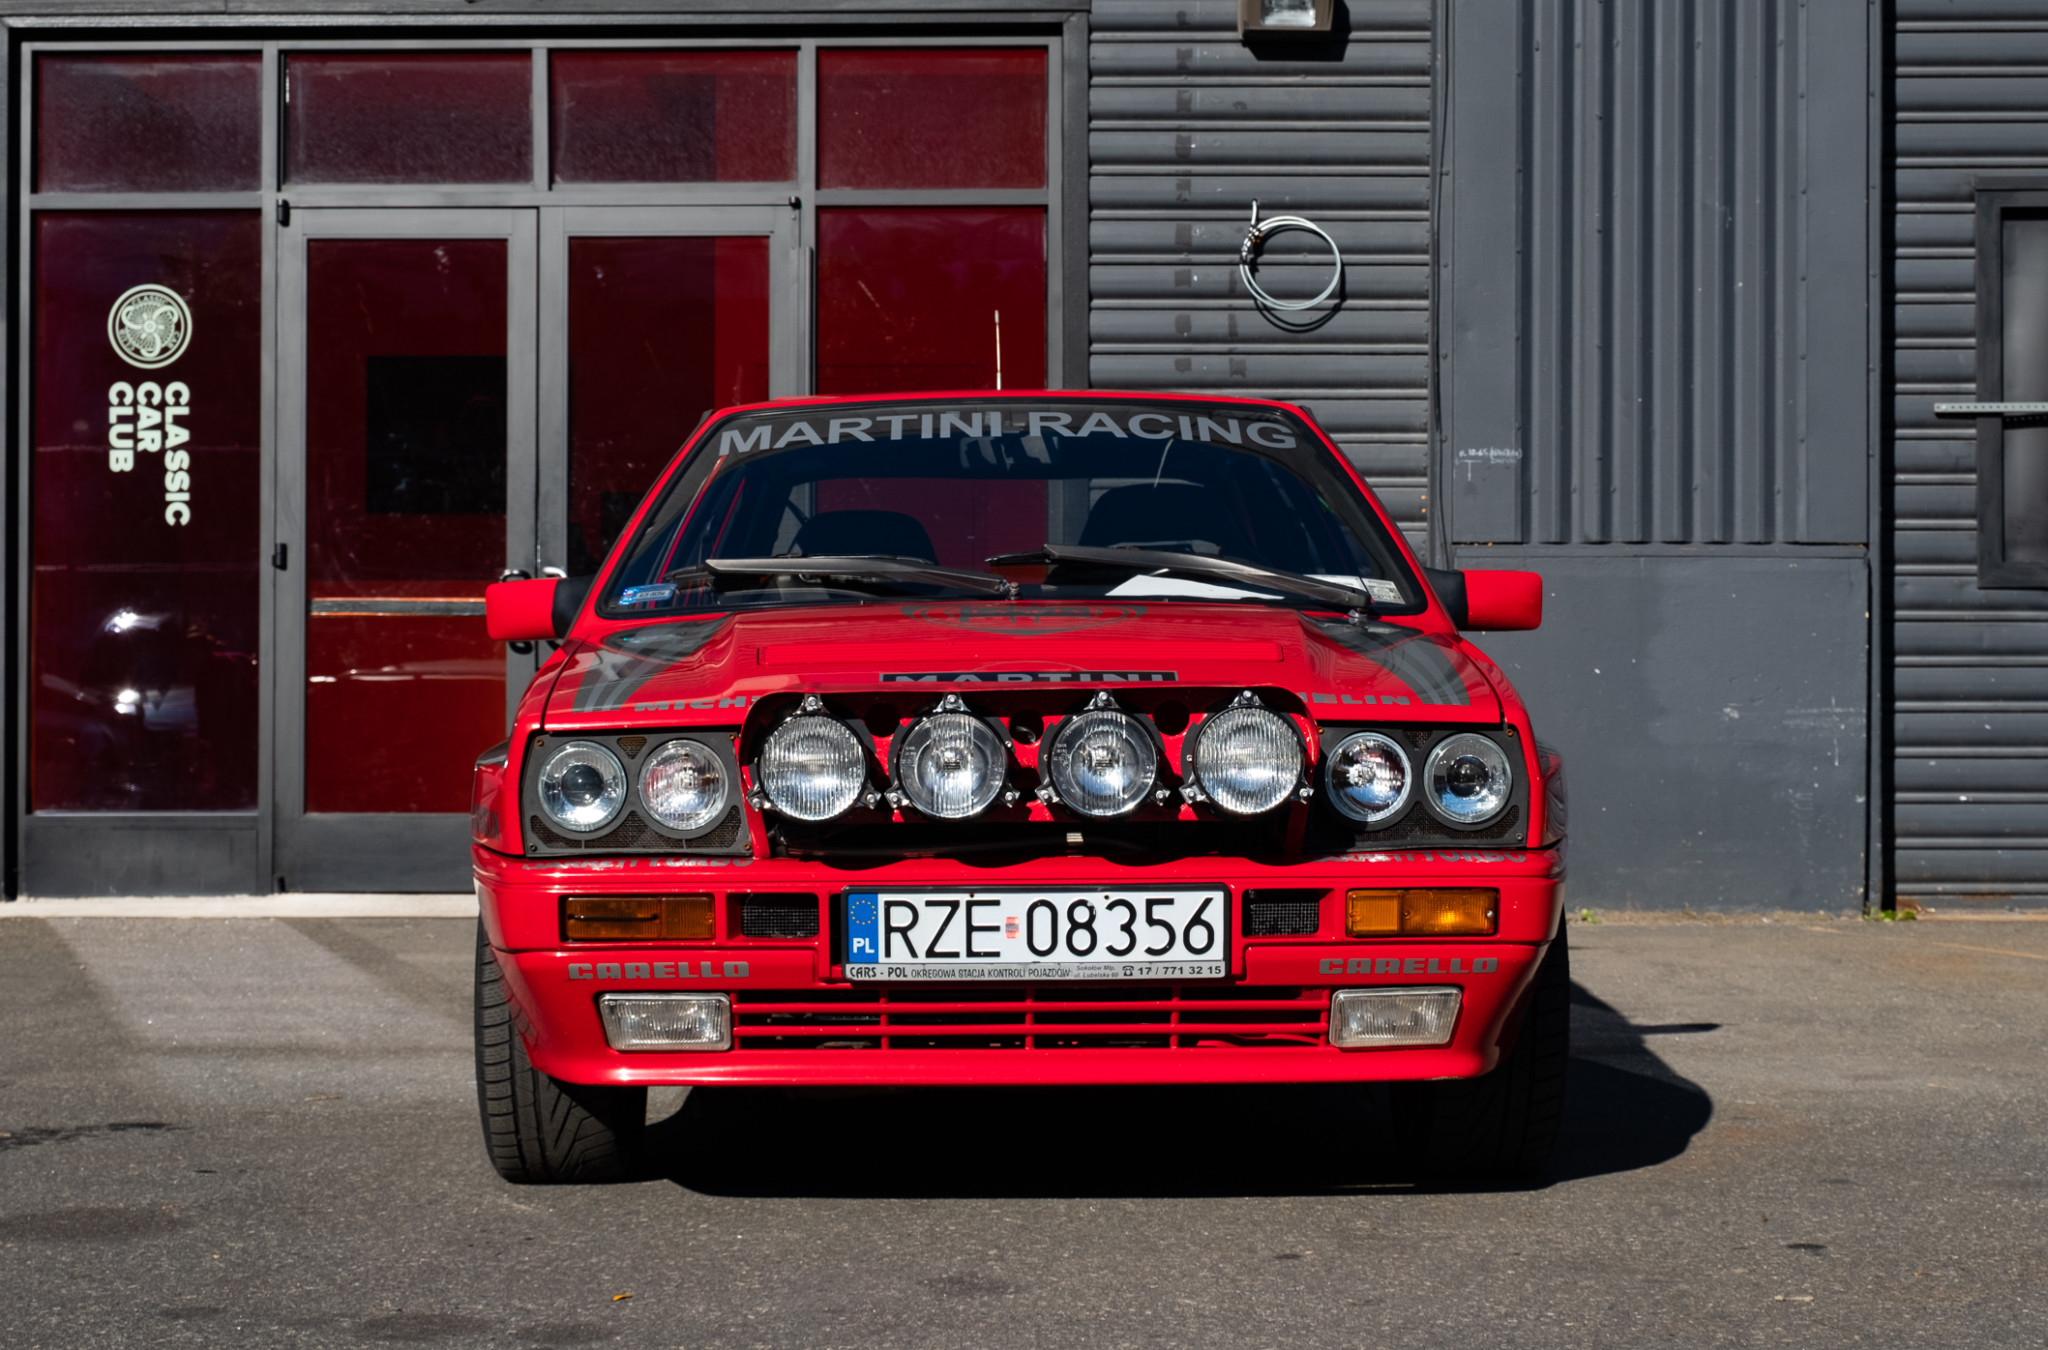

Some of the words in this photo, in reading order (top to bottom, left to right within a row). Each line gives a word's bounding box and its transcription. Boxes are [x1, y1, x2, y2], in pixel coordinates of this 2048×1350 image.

[108, 381, 134, 473] CLUB
[136, 381, 162, 453] CAR
[719, 412, 1001, 455] MARTINI
[1029, 412, 1297, 449] RACING
[164, 381, 191, 527] CLASSIC
[884, 899, 1001, 959] RZE
[1026, 897, 1215, 958] 08356
[853, 937, 875, 953] PL
[568, 961, 749, 979] CARELLO
[850, 966, 877, 978] CARS
[887, 966, 908, 978] POL
[958, 968, 985, 979] STACJA
[987, 967, 1026, 979] KONTROLI
[1137, 967, 1152, 976] 17
[1162, 967, 1184, 976] 771
[1188, 966, 1203, 975] 32
[1207, 966, 1221, 975] 15
[1319, 958, 1498, 974] CARELLO
